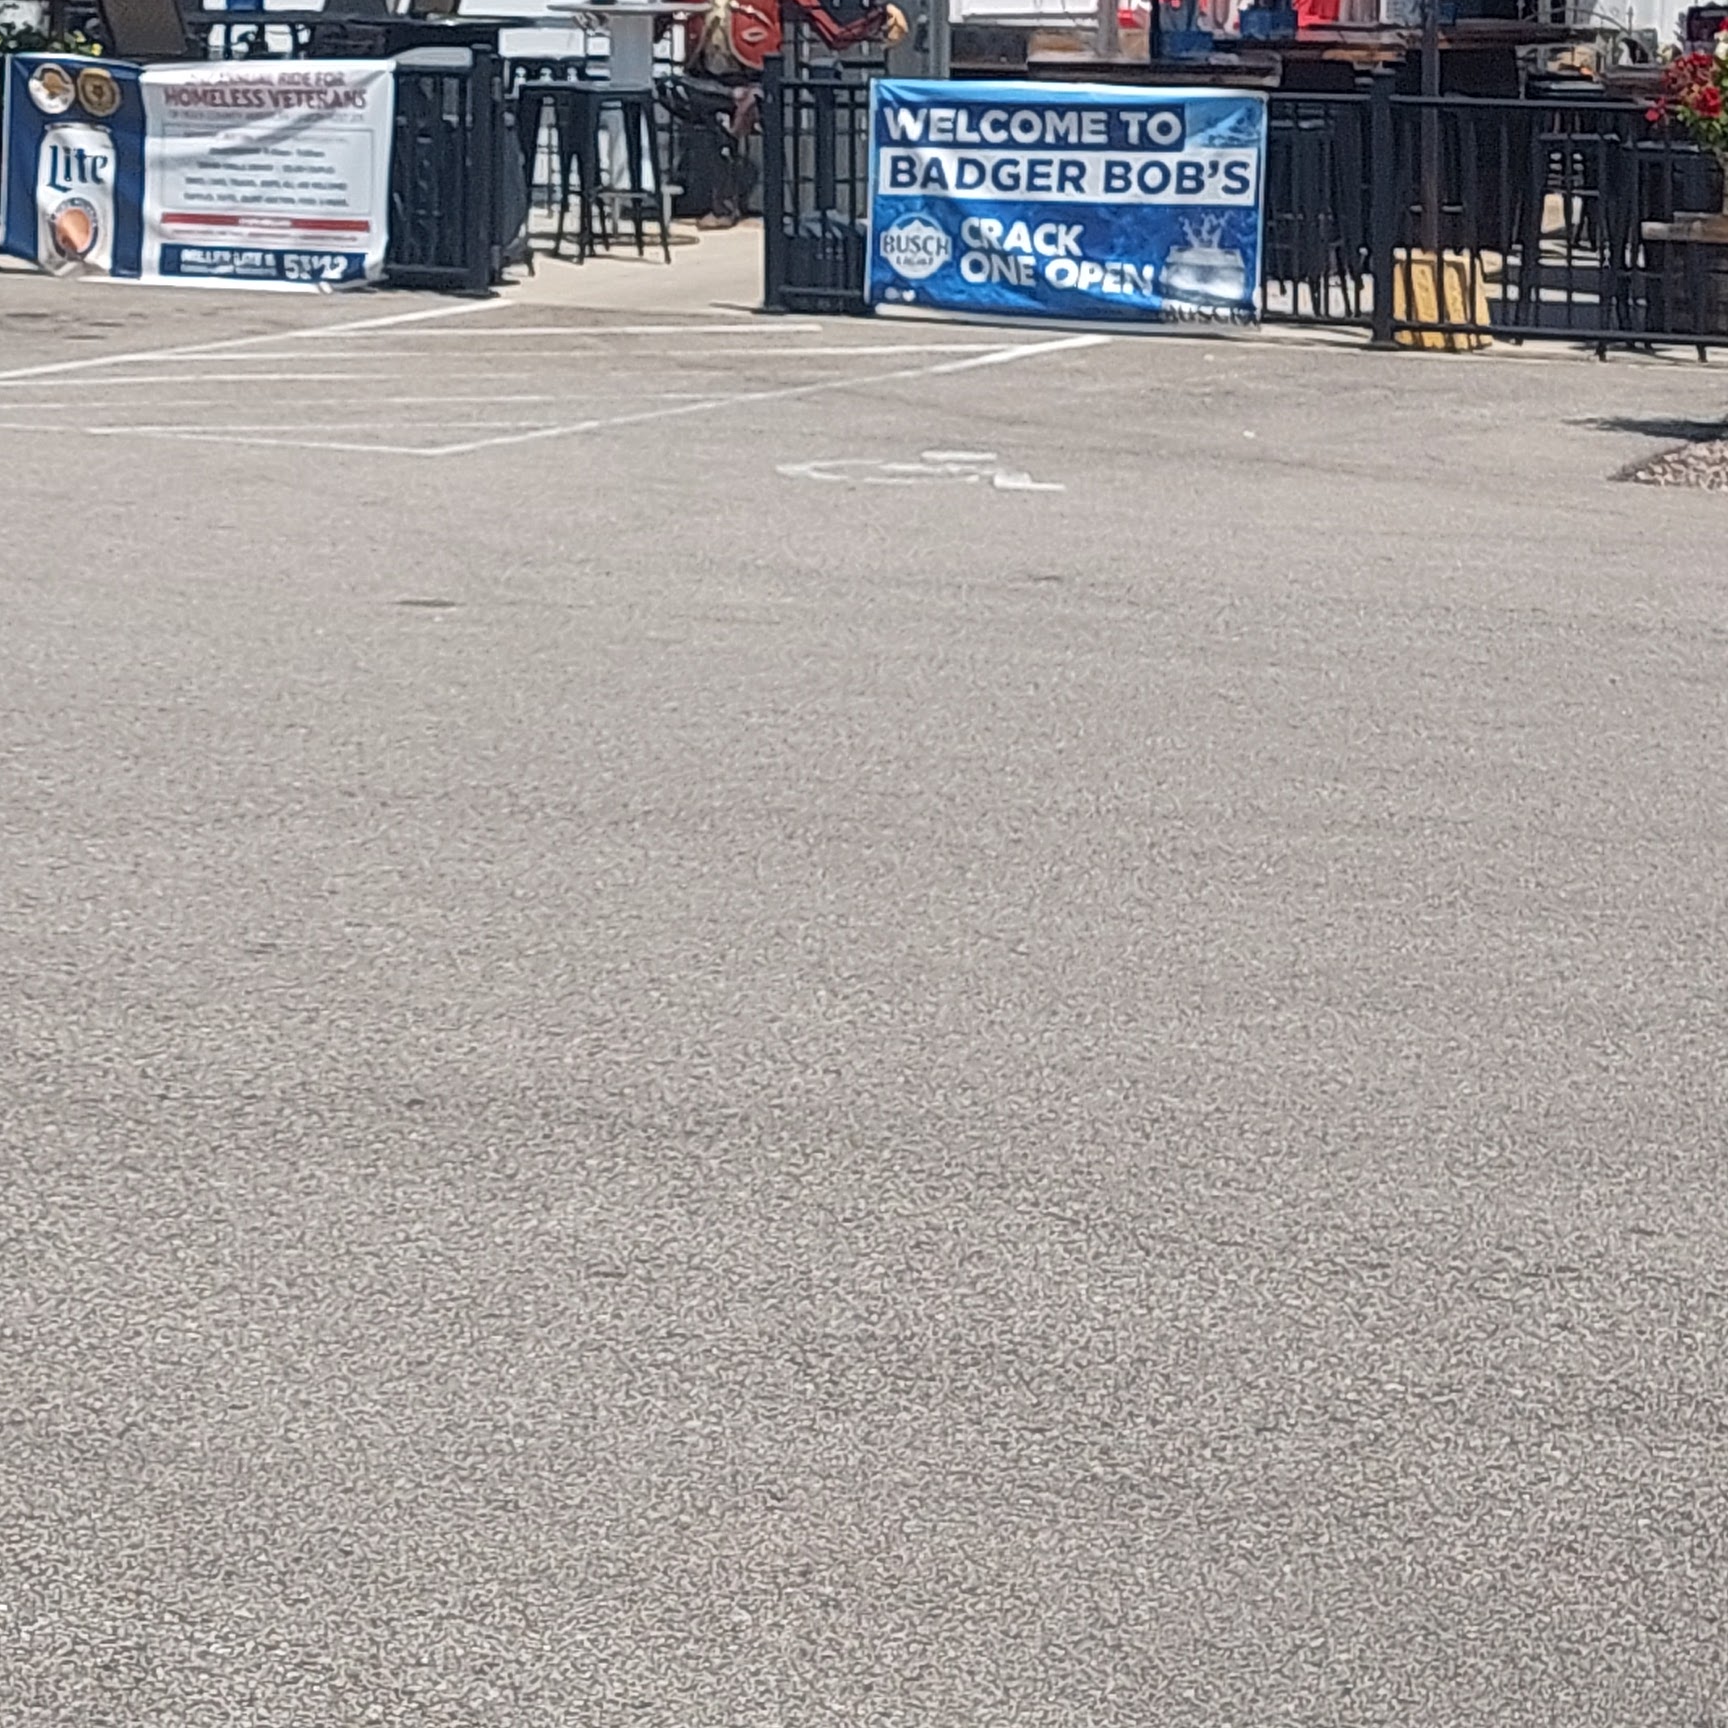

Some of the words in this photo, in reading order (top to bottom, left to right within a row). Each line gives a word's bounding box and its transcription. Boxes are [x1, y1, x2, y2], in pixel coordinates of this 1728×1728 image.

[315, 71, 346, 86] FOR
[164, 88, 263, 108] HOMELESS
[267, 89, 367, 109] VETERANS
[883, 107, 1108, 145] WELCOME
[1119, 111, 1182, 145] TO
[46, 144, 108, 193] Lite
[889, 155, 1086, 193] BADGER
[1103, 160, 1251, 195] BOB'S
[883, 234, 949, 256] BUSCH
[960, 216, 1084, 256] CRACK
[960, 252, 1034, 286] ONE
[1044, 259, 1153, 297] OPEN
